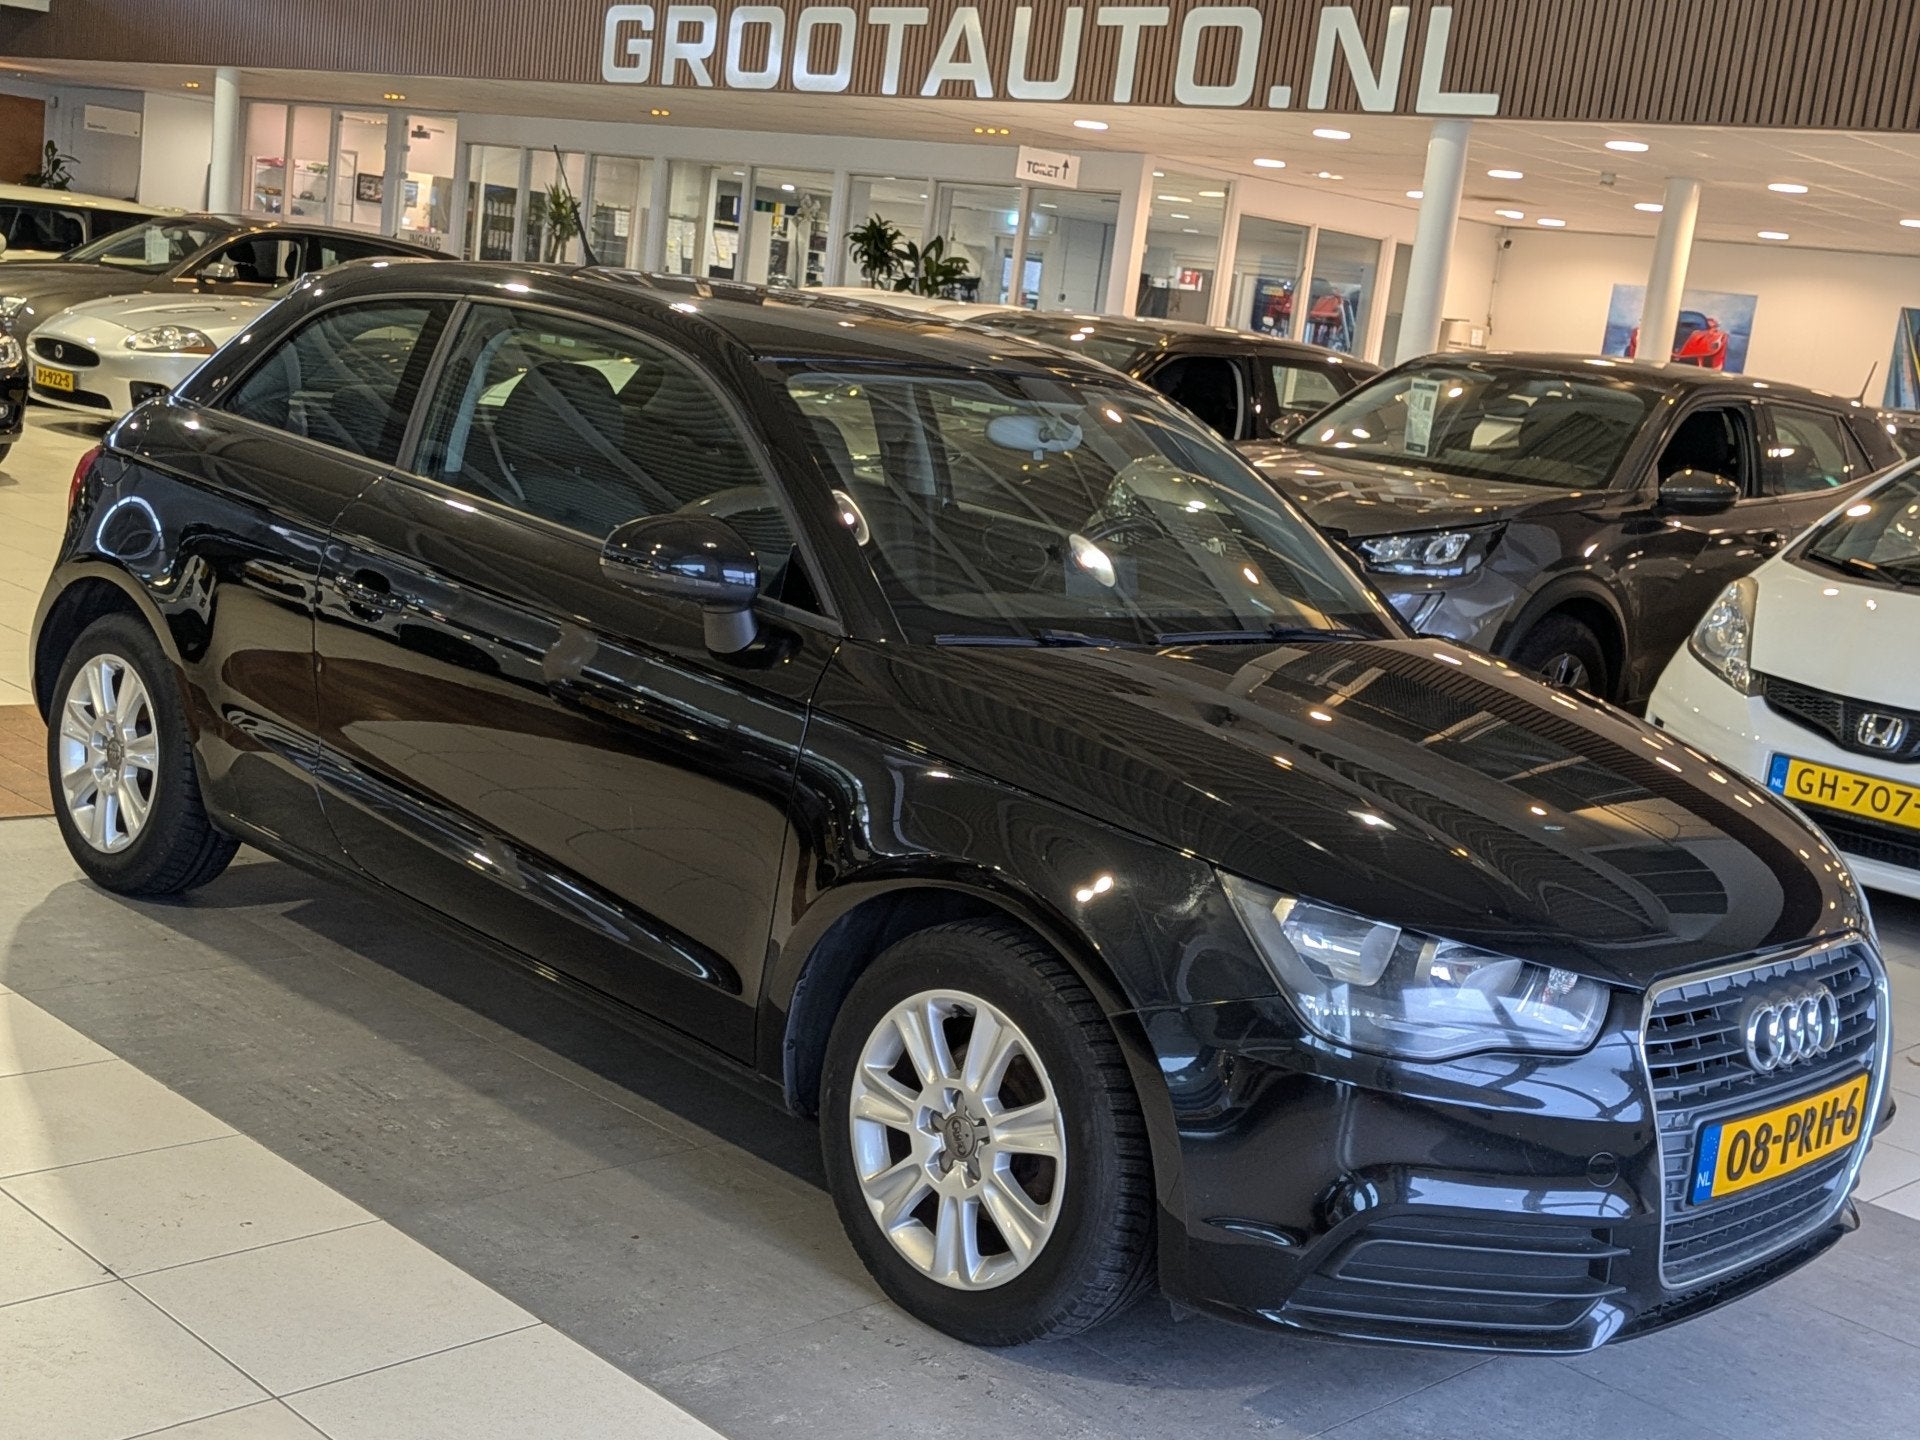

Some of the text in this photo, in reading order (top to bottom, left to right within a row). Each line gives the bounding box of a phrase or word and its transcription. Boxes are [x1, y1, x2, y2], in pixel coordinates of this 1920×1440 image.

[602, 3, 1500, 117] GROOTAUTO.NL
[1026, 160, 1060, 178] TOILET
[1771, 777, 1783, 788] NL
[1696, 1087, 1860, 1188] NL 08-PRH-6
